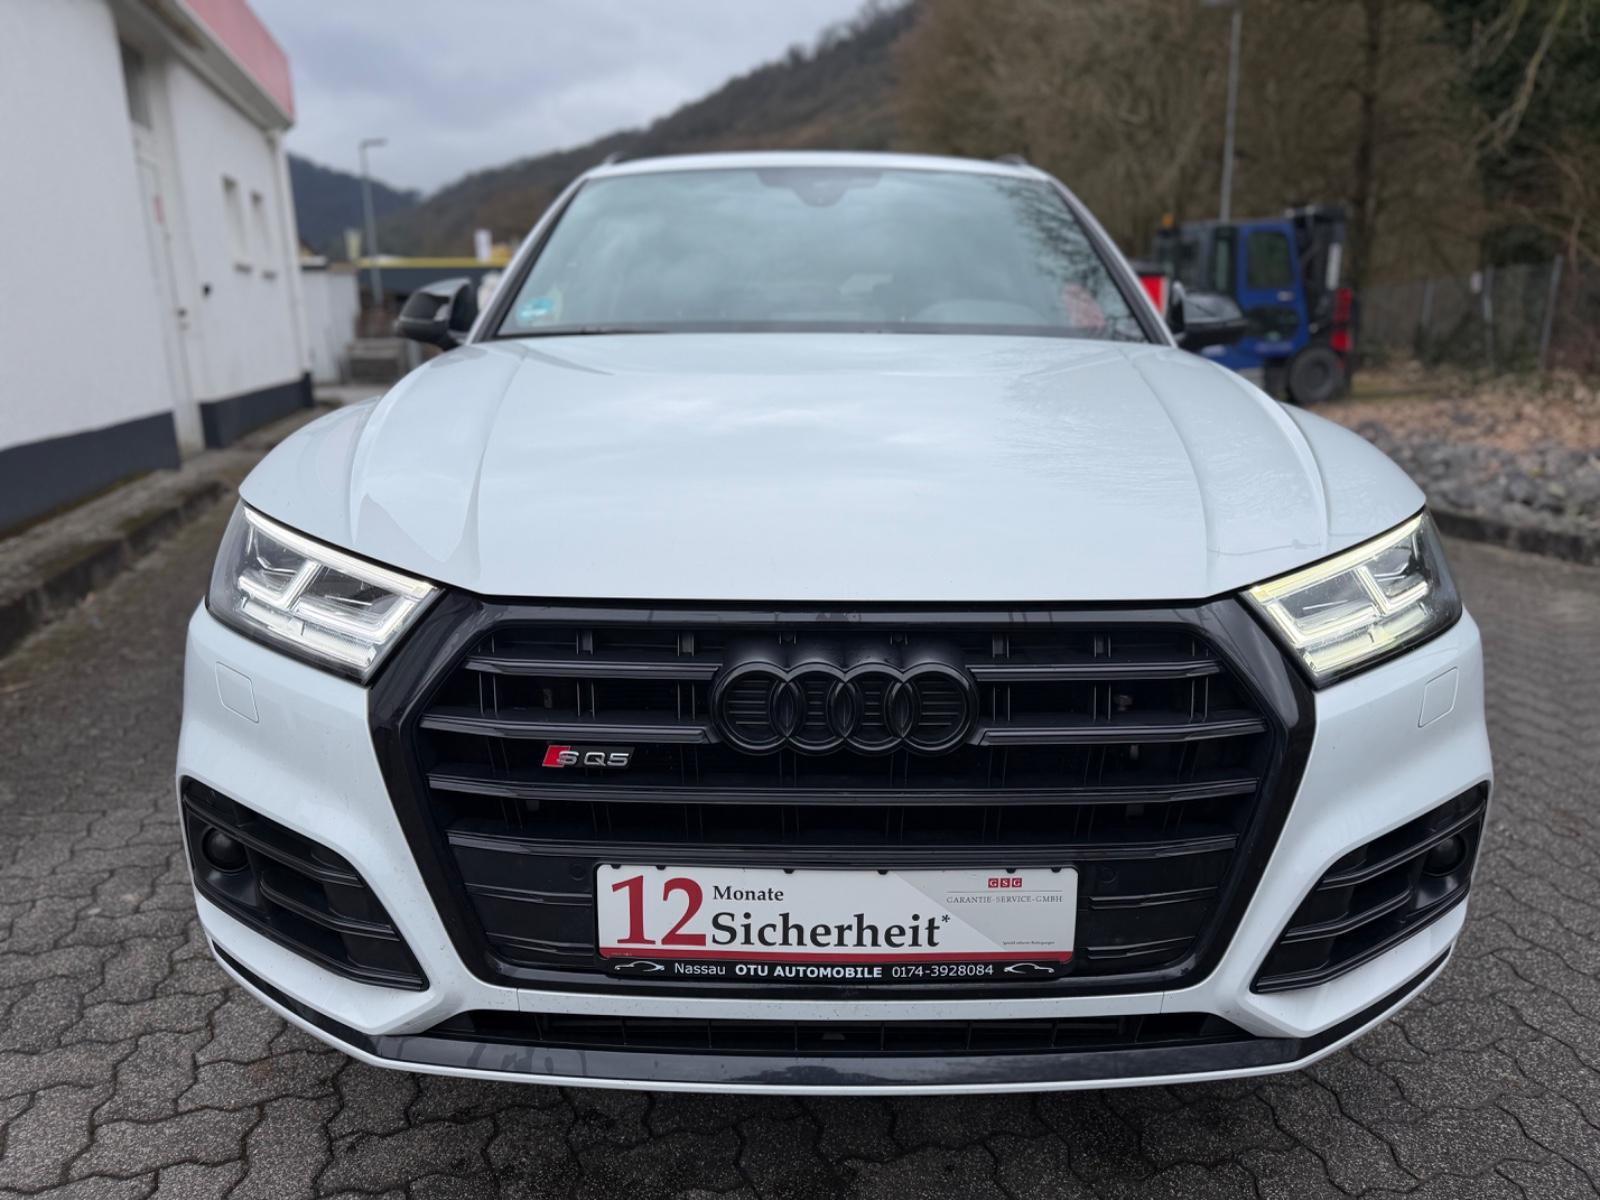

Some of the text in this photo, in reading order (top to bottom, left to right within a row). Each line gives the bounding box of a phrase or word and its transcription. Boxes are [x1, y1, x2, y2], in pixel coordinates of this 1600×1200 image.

[988, 878, 1022, 888] GSG
[713, 885, 785, 902] Monate
[611, 874, 707, 947] 12
[674, 962, 994, 979] Nassau OTU AUTOMOBILE 0174-3928084
